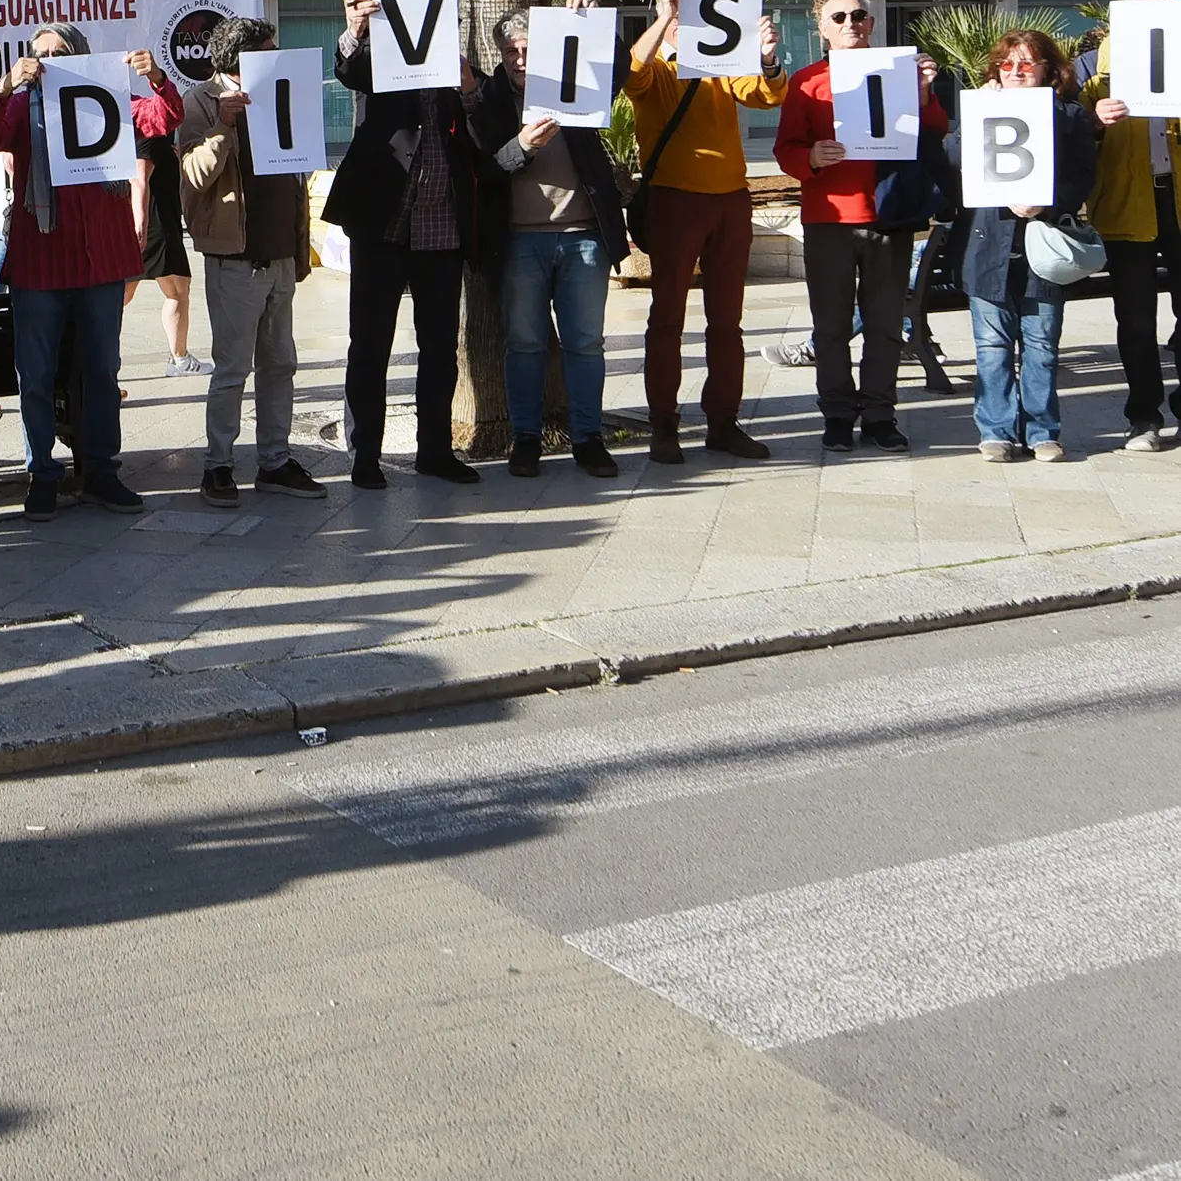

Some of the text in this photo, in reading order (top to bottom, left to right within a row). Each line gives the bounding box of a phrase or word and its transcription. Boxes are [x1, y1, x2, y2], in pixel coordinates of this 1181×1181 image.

[161, 27, 170, 42] DEI
[194, 0, 210, 8] PER
[560, 35, 579, 103] I
[1150, 28, 1165, 94] I
[59, 84, 121, 160] D
[275, 78, 293, 150] I
[866, 74, 885, 139] I
[983, 117, 1035, 182] B
